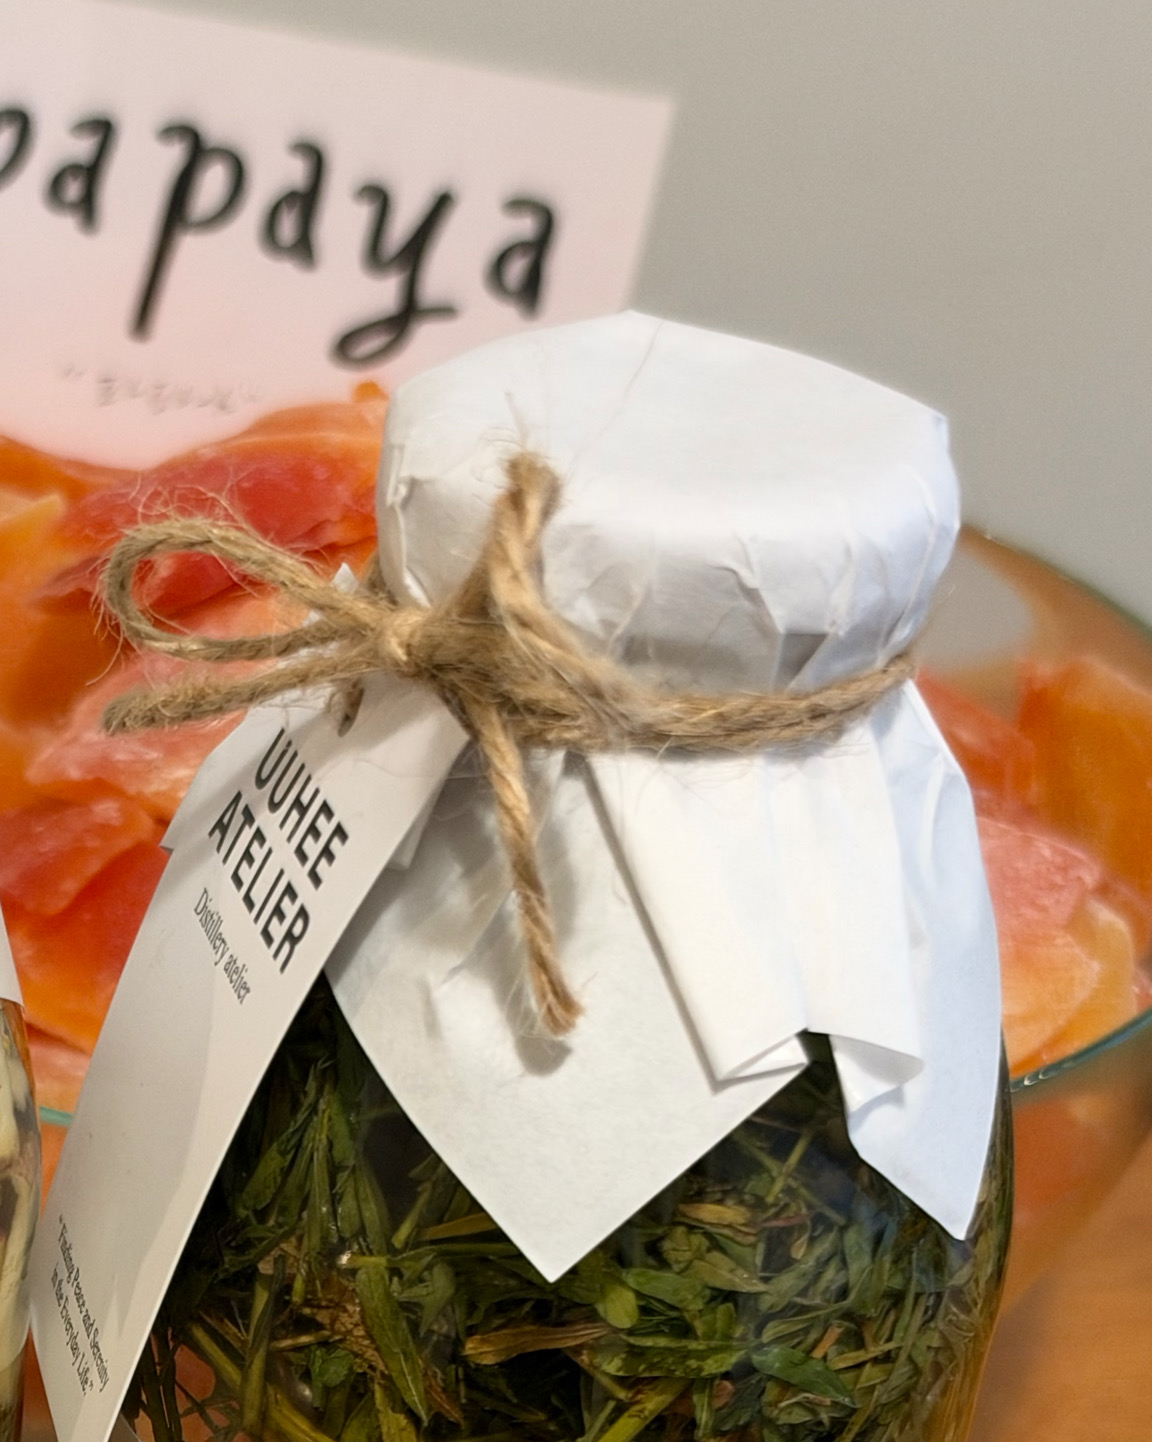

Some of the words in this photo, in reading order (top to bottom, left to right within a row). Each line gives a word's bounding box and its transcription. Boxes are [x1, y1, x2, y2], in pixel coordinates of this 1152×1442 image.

[254, 727, 348, 891] UUHEE
[208, 789, 310, 974] ATELIER
[194, 887, 229, 967] Distillery
[223, 952, 250, 1005] atelier
[55, 1279, 63, 1307] the
[60, 1295, 80, 1366] Everyday
[71, 1267, 86, 1314] Peace
[82, 1308, 95, 1339] and
[89, 1327, 109, 1393] Serenity
